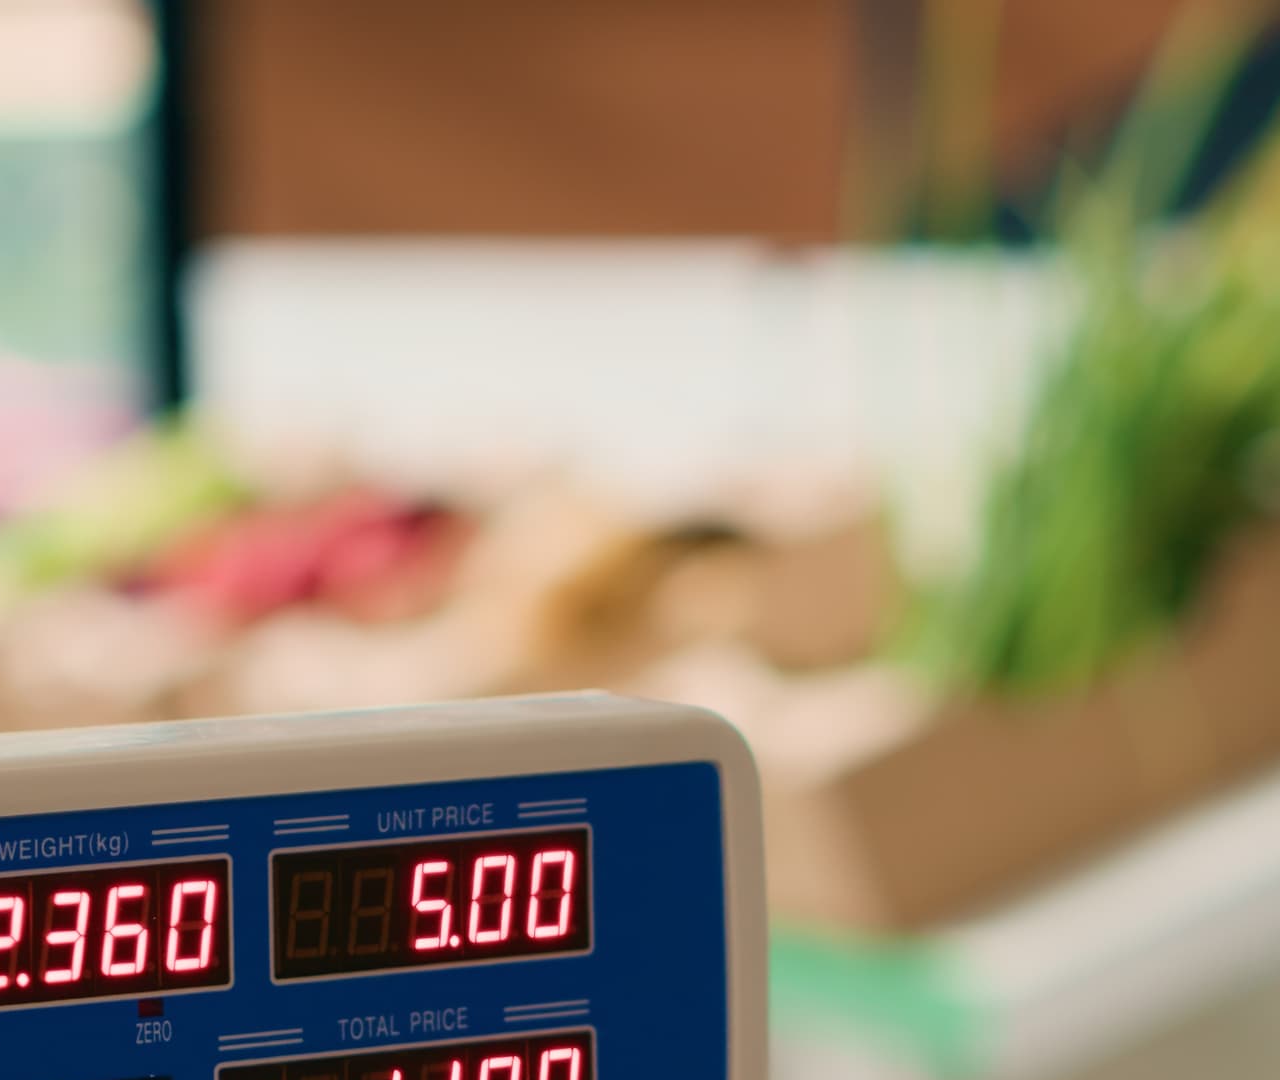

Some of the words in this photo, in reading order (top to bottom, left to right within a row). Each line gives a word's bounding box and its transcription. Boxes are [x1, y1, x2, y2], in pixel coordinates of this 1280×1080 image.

[377, 808, 425, 833] UNIT
[432, 803, 495, 828] PRICE
[411, 850, 575, 951] 5.00
[135, 1020, 173, 1045] ZERO
[337, 1014, 401, 1041] TOTAL
[409, 1006, 470, 1034] PRICE
